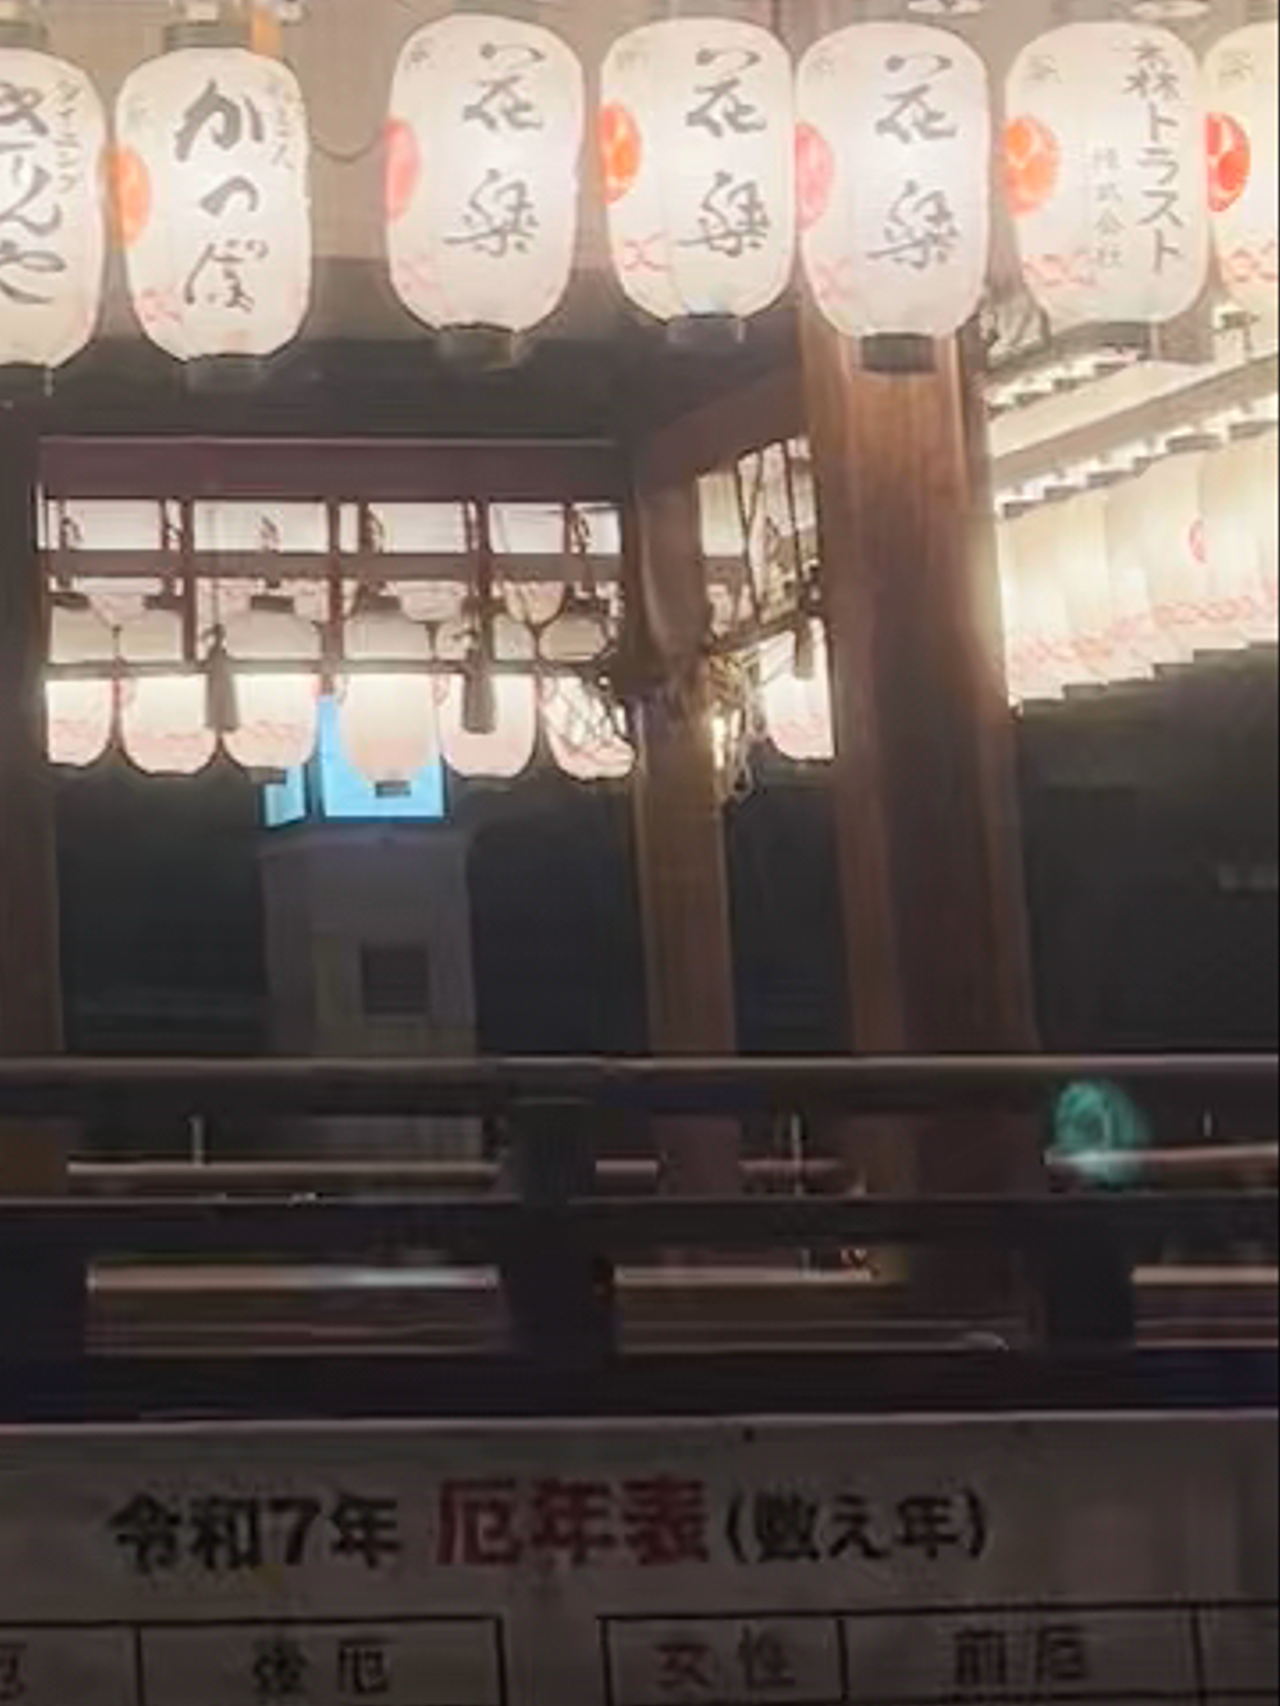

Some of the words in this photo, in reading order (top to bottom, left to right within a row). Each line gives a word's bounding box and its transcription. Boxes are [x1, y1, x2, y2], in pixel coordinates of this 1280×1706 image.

[1122, 39, 1188, 274] 森トラスト
[108, 1491, 403, 1570] 令和7年
